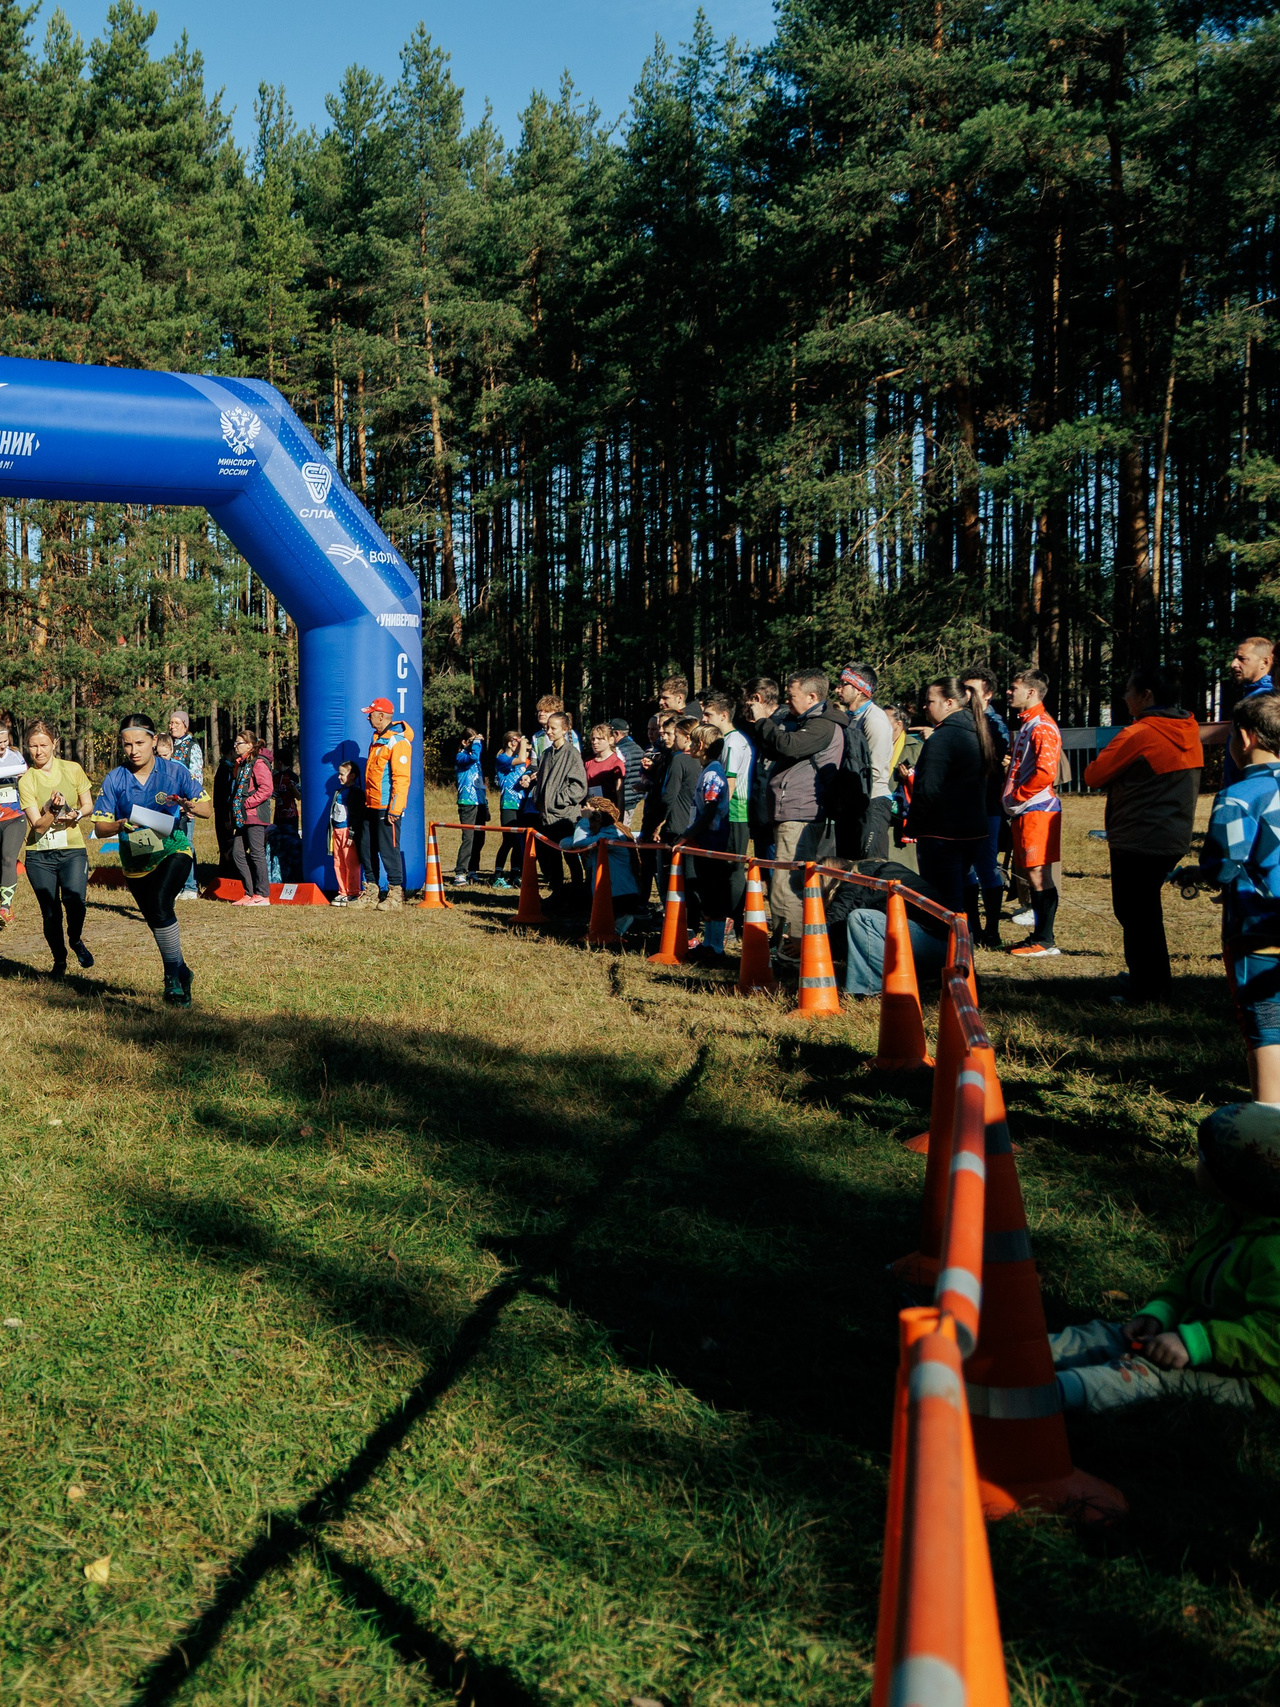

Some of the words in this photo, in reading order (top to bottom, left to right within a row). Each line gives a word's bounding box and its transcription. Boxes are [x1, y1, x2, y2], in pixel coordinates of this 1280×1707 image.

[217, 457, 257, 467] МИНСПОРТ
[218, 467, 249, 476] РОССИИ
[299, 508, 336, 519] СЛЛА
[369, 551, 400, 566] ВФЛА
[138, 836, 151, 849] 5.1
